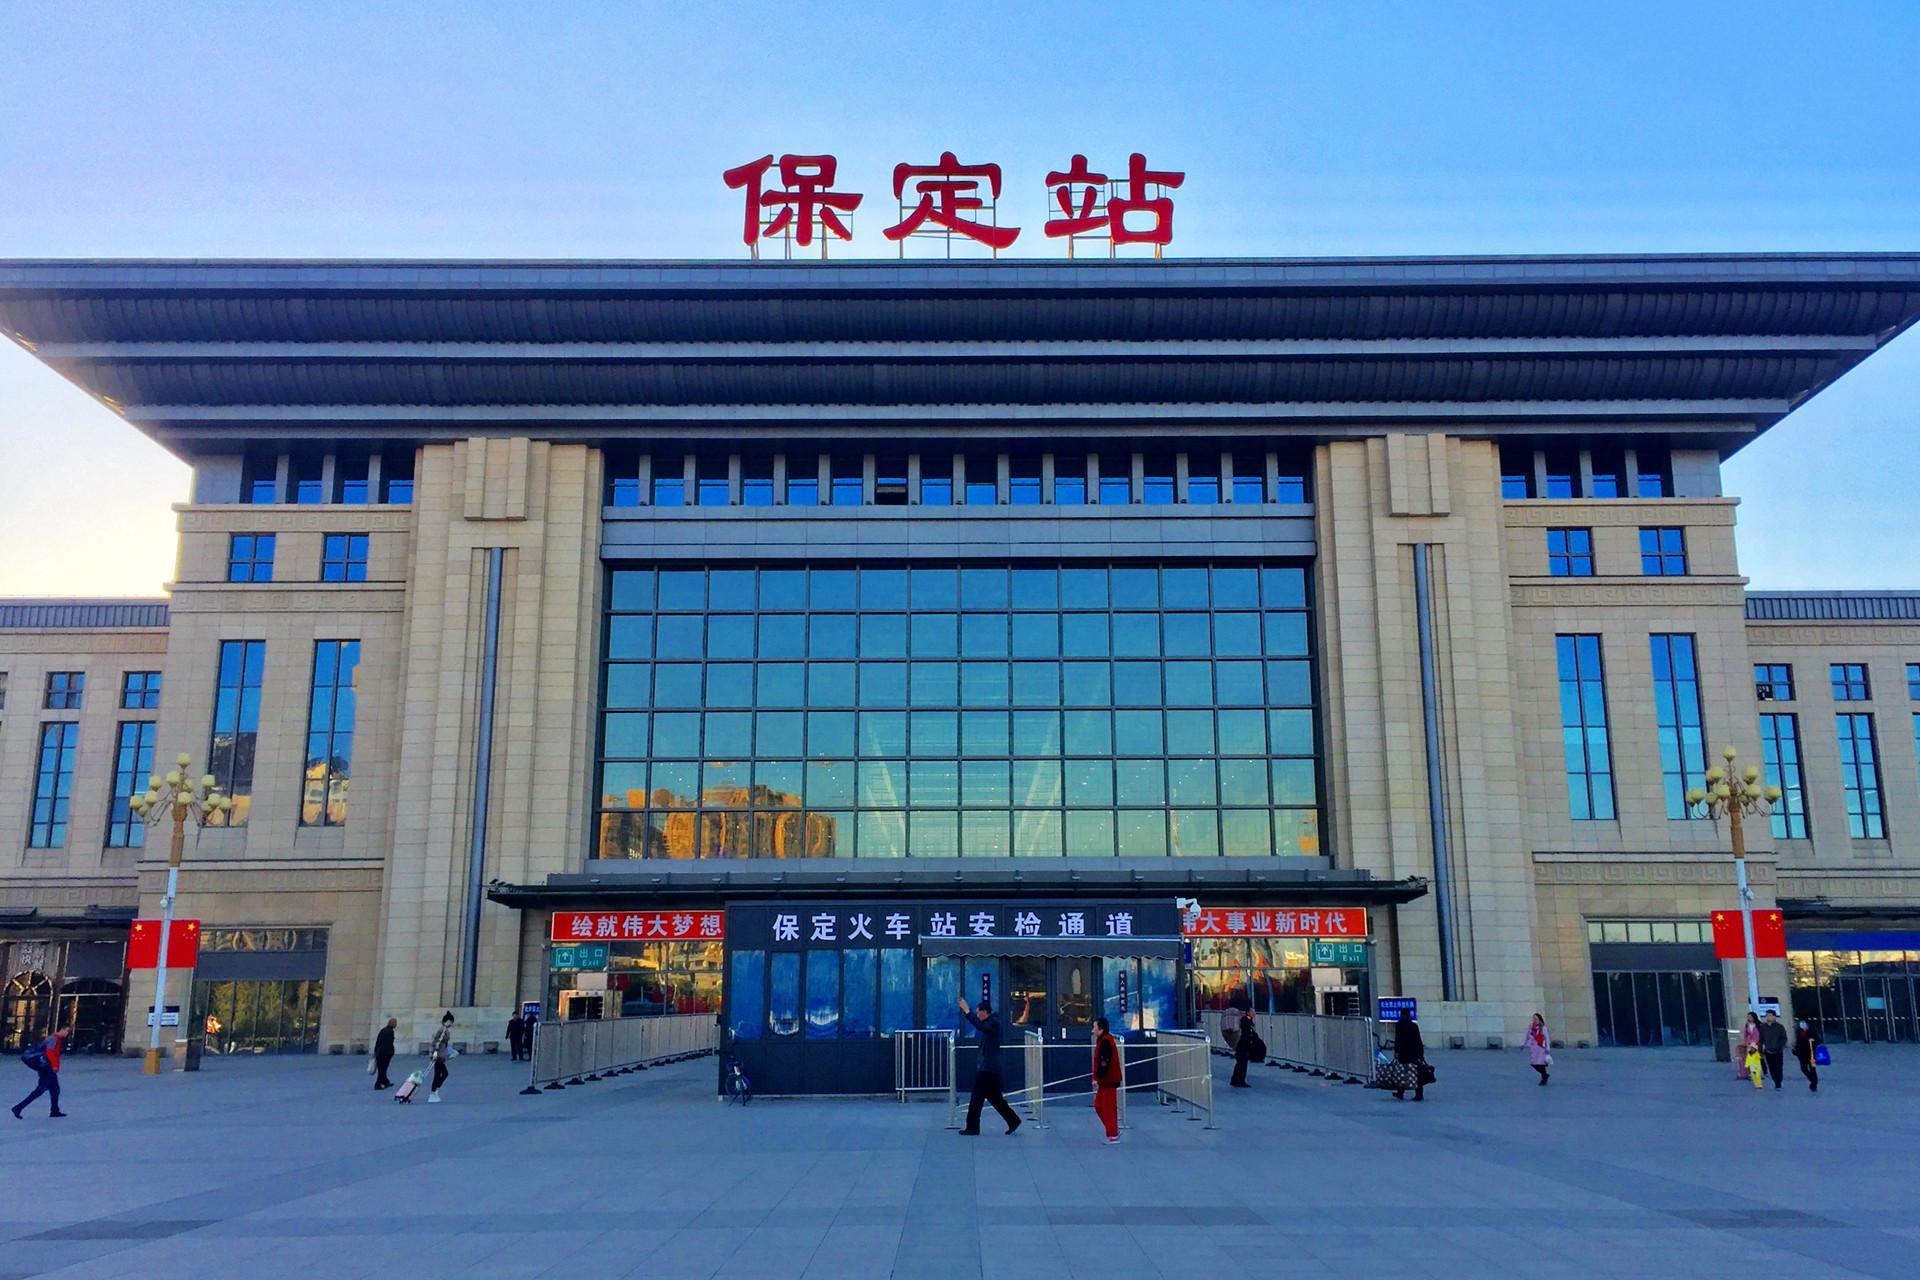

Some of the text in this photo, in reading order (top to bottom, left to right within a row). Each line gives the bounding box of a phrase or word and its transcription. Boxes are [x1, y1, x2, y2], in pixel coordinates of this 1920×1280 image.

[723, 151, 1185, 249] 保定站
[571, 914, 722, 937] 绘就伟大梦想
[772, 912, 1133, 941] 保定火车站安检通道
[579, 949, 603, 958] 出口
[1339, 943, 1363, 953] 出口
[582, 959, 599, 967] Exit
